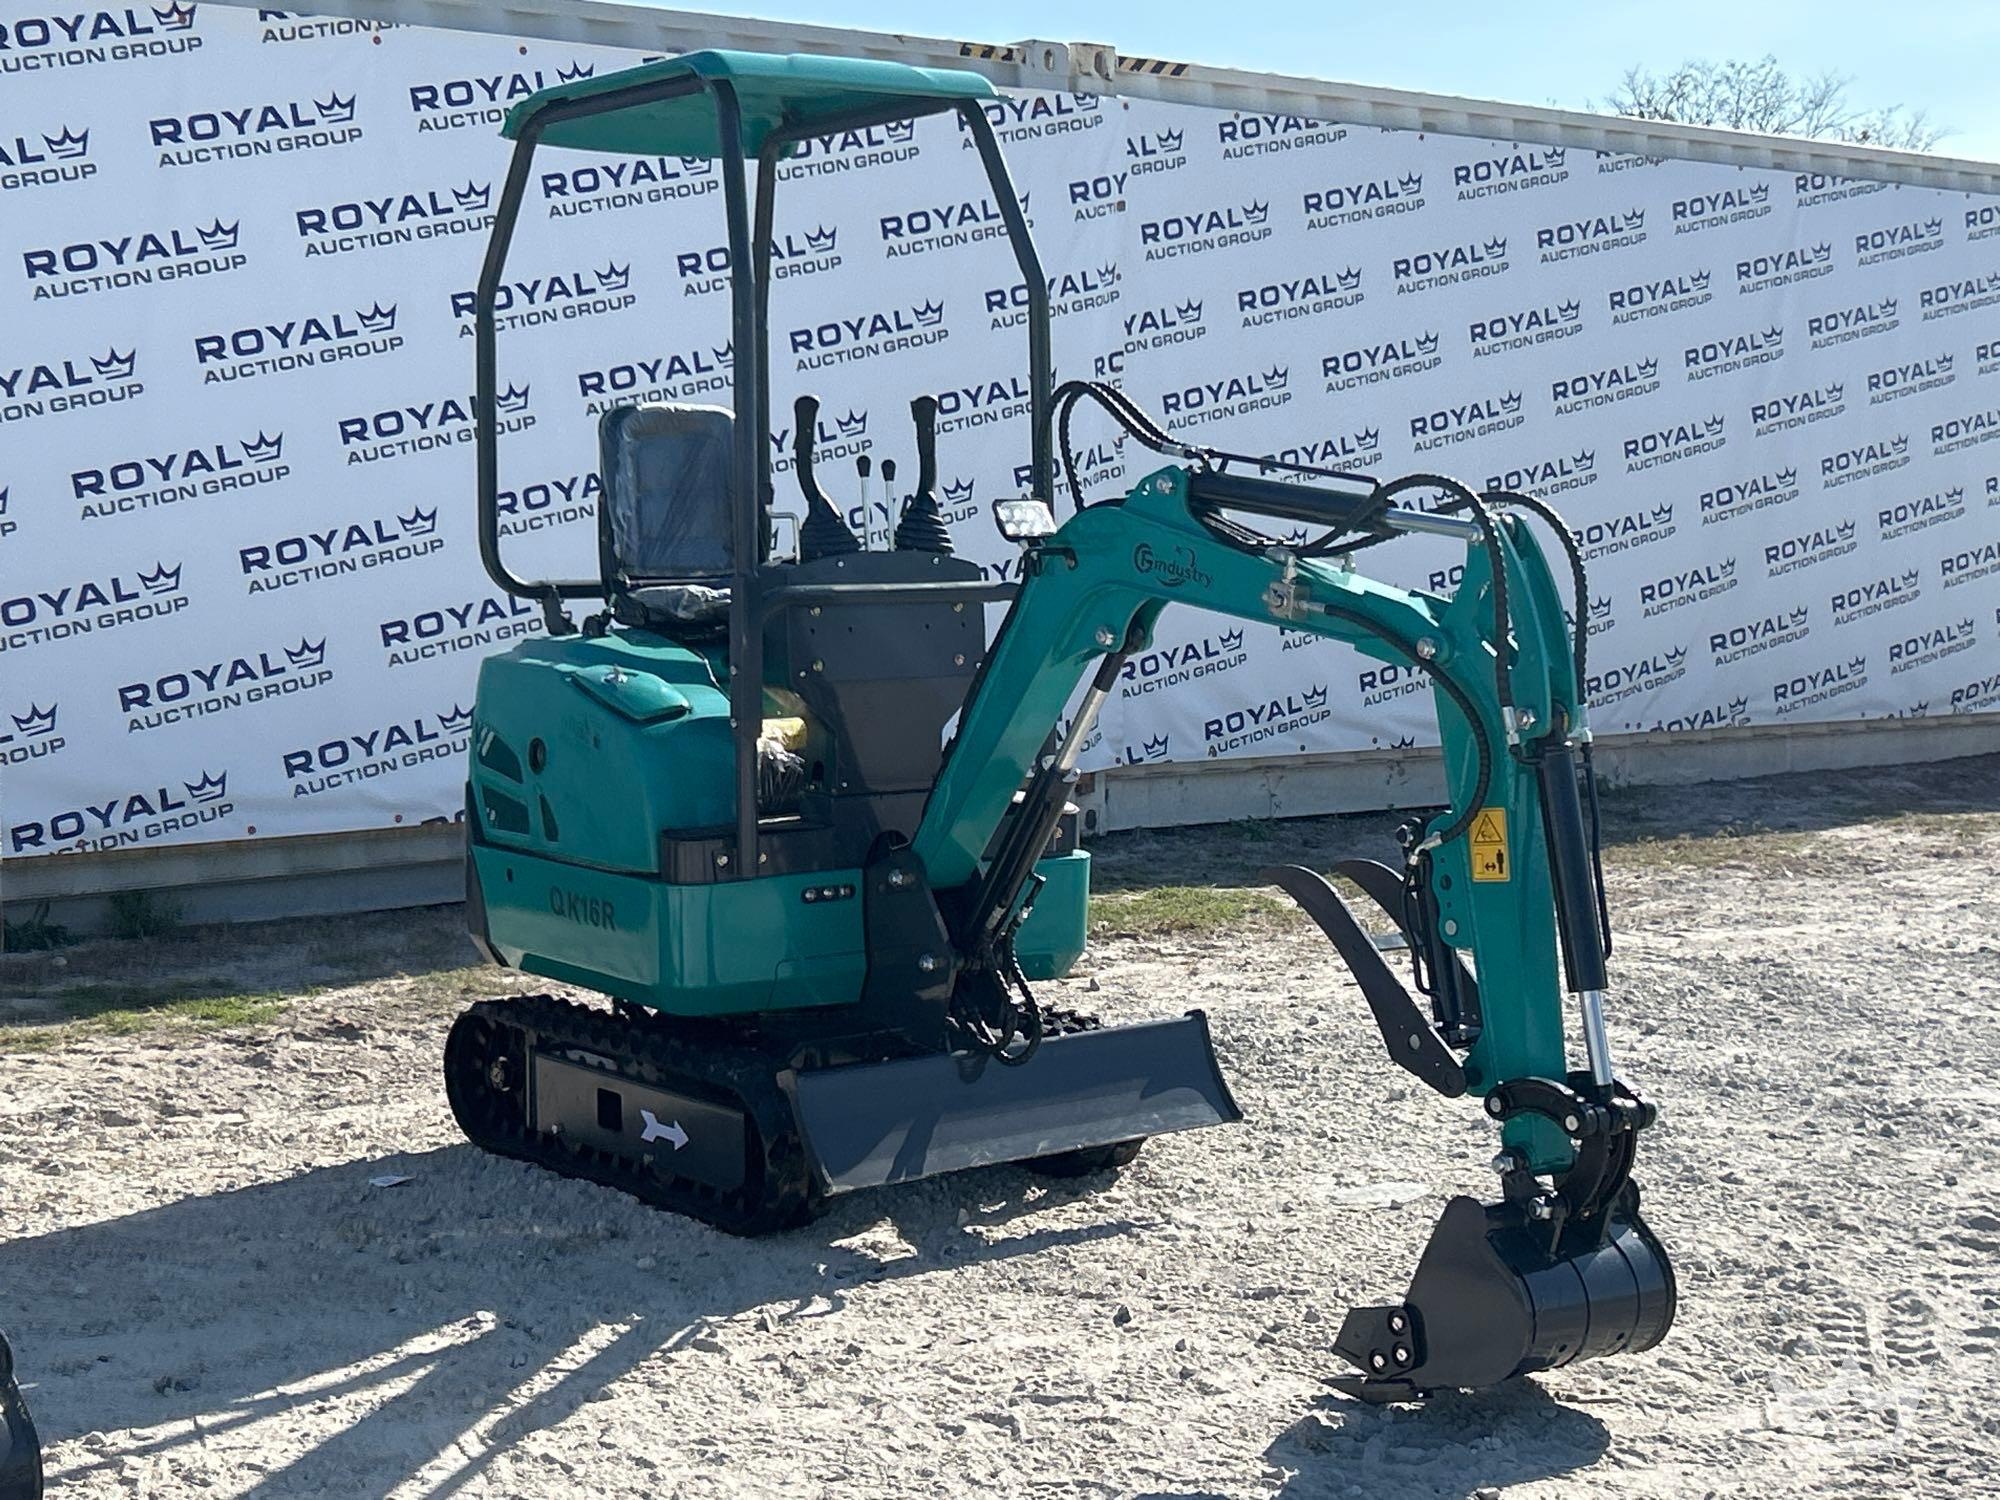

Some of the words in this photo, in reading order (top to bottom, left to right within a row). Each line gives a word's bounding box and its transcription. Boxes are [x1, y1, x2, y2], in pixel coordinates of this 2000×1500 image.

[110, 36, 204, 60] GROUP
[149, 102, 316, 146] ROYAL
[1044, 115, 1104, 135] GROUP
[1293, 129, 1347, 148] GROUP
[158, 139, 272, 167] AUCTION
[276, 127, 363, 151] GROUP
[853, 146, 920, 168] GROUP
[1222, 138, 1291, 160] AUCTION
[0, 163, 97, 189] GROUP
[540, 157, 681, 199] ROYAL
[1129, 155, 1187, 176] GROUP
[1454, 153, 1543, 186] ROYAL
[547, 191, 643, 218] AUCTION
[646, 179, 720, 202] GROUP
[1303, 180, 1399, 214] ROYAL
[1457, 179, 1518, 201] AUCTION
[1520, 170, 1567, 189] GROUP
[296, 191, 453, 236] ROYAL
[881, 200, 1000, 239] ROYAL
[1306, 207, 1372, 230] AUCTION
[1374, 197, 1426, 217] GROUP
[1671, 189, 1750, 220] ROYAL
[1674, 214, 1728, 235] AUCTION
[1729, 205, 1772, 223] GROUP
[305, 227, 411, 257] AUCTION
[415, 214, 497, 239] GROUP
[886, 231, 968, 257] AUCTION
[1139, 208, 1244, 245] ROYAL
[1143, 237, 1215, 261] AUCTION
[1217, 226, 1272, 247] GROUP
[1539, 216, 1623, 249] ROYAL
[1855, 223, 1925, 253] ROYAL
[23, 230, 199, 279] ROYAL
[1393, 244, 1485, 280] ROYAL
[1541, 241, 1600, 264] AUCTION
[1601, 232, 1647, 251] GROUP
[1737, 249, 1812, 281] ROYAL
[33, 268, 152, 300] AUCTION
[157, 253, 248, 281] GROUP
[774, 255, 843, 279] GROUP
[1396, 271, 1459, 295] AUCTION
[1461, 261, 1510, 281] GROUP
[1739, 273, 1791, 295] AUCTION
[1792, 263, 1833, 282] GROUP
[561, 293, 637, 319] GROUP
[1070, 290, 1121, 313] GROUP
[1238, 275, 1337, 312] ROYAL
[1241, 303, 1310, 328] AUCTION
[1312, 292, 1364, 313] GROUP
[1609, 277, 1691, 311] ROYAL
[1612, 302, 1668, 325] AUCTION
[1669, 292, 1713, 312] GROUP
[1920, 278, 1987, 309] ROYAL
[789, 310, 913, 353] ROYAL
[1150, 325, 1207, 348] GROUP
[1470, 308, 1558, 343] ROYAL
[1808, 304, 1880, 336] ROYAL
[195, 314, 358, 364] ROYAL
[795, 342, 880, 371] AUCTION
[882, 328, 948, 353] GROUP
[1473, 334, 1533, 358] AUCTION
[1535, 323, 1582, 343] GROUP
[1685, 334, 1763, 368] ROYAL
[203, 351, 314, 384] AUCTION
[319, 335, 403, 363] GROUP
[577, 351, 715, 397] ROYAL
[1321, 340, 1416, 378] ROYAL
[1325, 368, 1390, 393] AUCTION
[1392, 356, 1443, 377] GROUP
[1687, 359, 1741, 382] AUCTION
[1742, 348, 1784, 368] GROUP
[1867, 360, 1937, 392] ROYAL
[48, 382, 143, 412] GROUP
[1161, 375, 1263, 415] ROYAL
[1553, 365, 1637, 401] ROYAL
[1556, 391, 1614, 416] AUCTION
[1615, 380, 1660, 400] GROUP
[1869, 383, 1917, 406] AUCTION
[1918, 373, 1956, 392] GROUP
[1164, 404, 1235, 431] AUCTION
[1237, 391, 1292, 414] GROUP
[1410, 400, 1500, 438] ROYAL
[1751, 390, 1826, 424] ROYAL
[1753, 414, 1805, 438] AUCTION
[1806, 403, 1846, 423] GROUP
[1413, 427, 1475, 453] AUCTION
[1477, 415, 1525, 436] GROUP
[1624, 423, 1704, 459] ROYAL
[1931, 411, 1998, 444] ROYAL
[348, 431, 452, 465] AUCTION
[1331, 451, 1383, 474] GROUP
[1626, 449, 1682, 473] AUCTION
[1683, 437, 1726, 458] GROUP
[1820, 442, 1891, 476] ROYAL
[71, 445, 243, 499] ROYAL
[1486, 458, 1572, 497] ROYAL
[1550, 472, 1596, 494] GROUP
[1822, 466, 1871, 490] AUCTION
[1872, 455, 1911, 475] GROUP
[80, 483, 197, 520] AUCTION
[201, 464, 290, 495] GROUP
[1700, 476, 1776, 512] ROYAL
[1702, 501, 1755, 526] AUCTION
[1756, 488, 1798, 509] GROUP
[497, 503, 595, 537] AUCTION
[1878, 494, 1947, 528] ROYAL
[240, 519, 399, 574] ROYAL
[1630, 525, 1674, 547] GROUP
[1765, 528, 1838, 565] ROYAL
[248, 557, 356, 594] AUCTION
[360, 537, 443, 568] GROUP
[1767, 553, 1818, 578] AUCTION
[1819, 540, 1859, 561] GROUP
[1943, 565, 1989, 589] AUCTION
[1640, 566, 1719, 604] ROYAL
[1642, 592, 1697, 618] AUCTION
[1698, 578, 1740, 600] GROUP
[1831, 577, 1902, 613] ROYAL
[96, 595, 189, 629] GROUP
[381, 593, 531, 648] ROYAL
[1833, 601, 1882, 626] AUCTION
[1883, 588, 1921, 609] GROUP
[389, 629, 491, 667] AUCTION
[1710, 615, 1789, 653] ROYAL
[1716, 640, 1768, 667] AUCTION
[1769, 626, 1810, 648] GROUP
[1889, 626, 1957, 662] ROYAL
[1119, 669, 1190, 700] AUCTION
[1193, 652, 1248, 678] GROUP
[1120, 639, 1219, 684] ROYAL
[1586, 656, 1667, 696] ROYAL
[118, 653, 286, 713] ROYAL
[127, 692, 241, 733] AUCTION
[245, 669, 332, 702] GROUP
[1362, 678, 1426, 707] AUCTION
[1775, 664, 1848, 703] ROYAL
[1777, 689, 1827, 716] AUCTION
[1828, 675, 1868, 697] GROUP
[1203, 696, 1303, 741] ROYAL
[1277, 708, 1330, 734] GROUP
[284, 719, 440, 779] ROYAL
[292, 757, 398, 798] AUCTION
[11, 787, 185, 852] ROYAL
[143, 802, 234, 838] GROUP
[549, 885, 616, 932] QK16R
